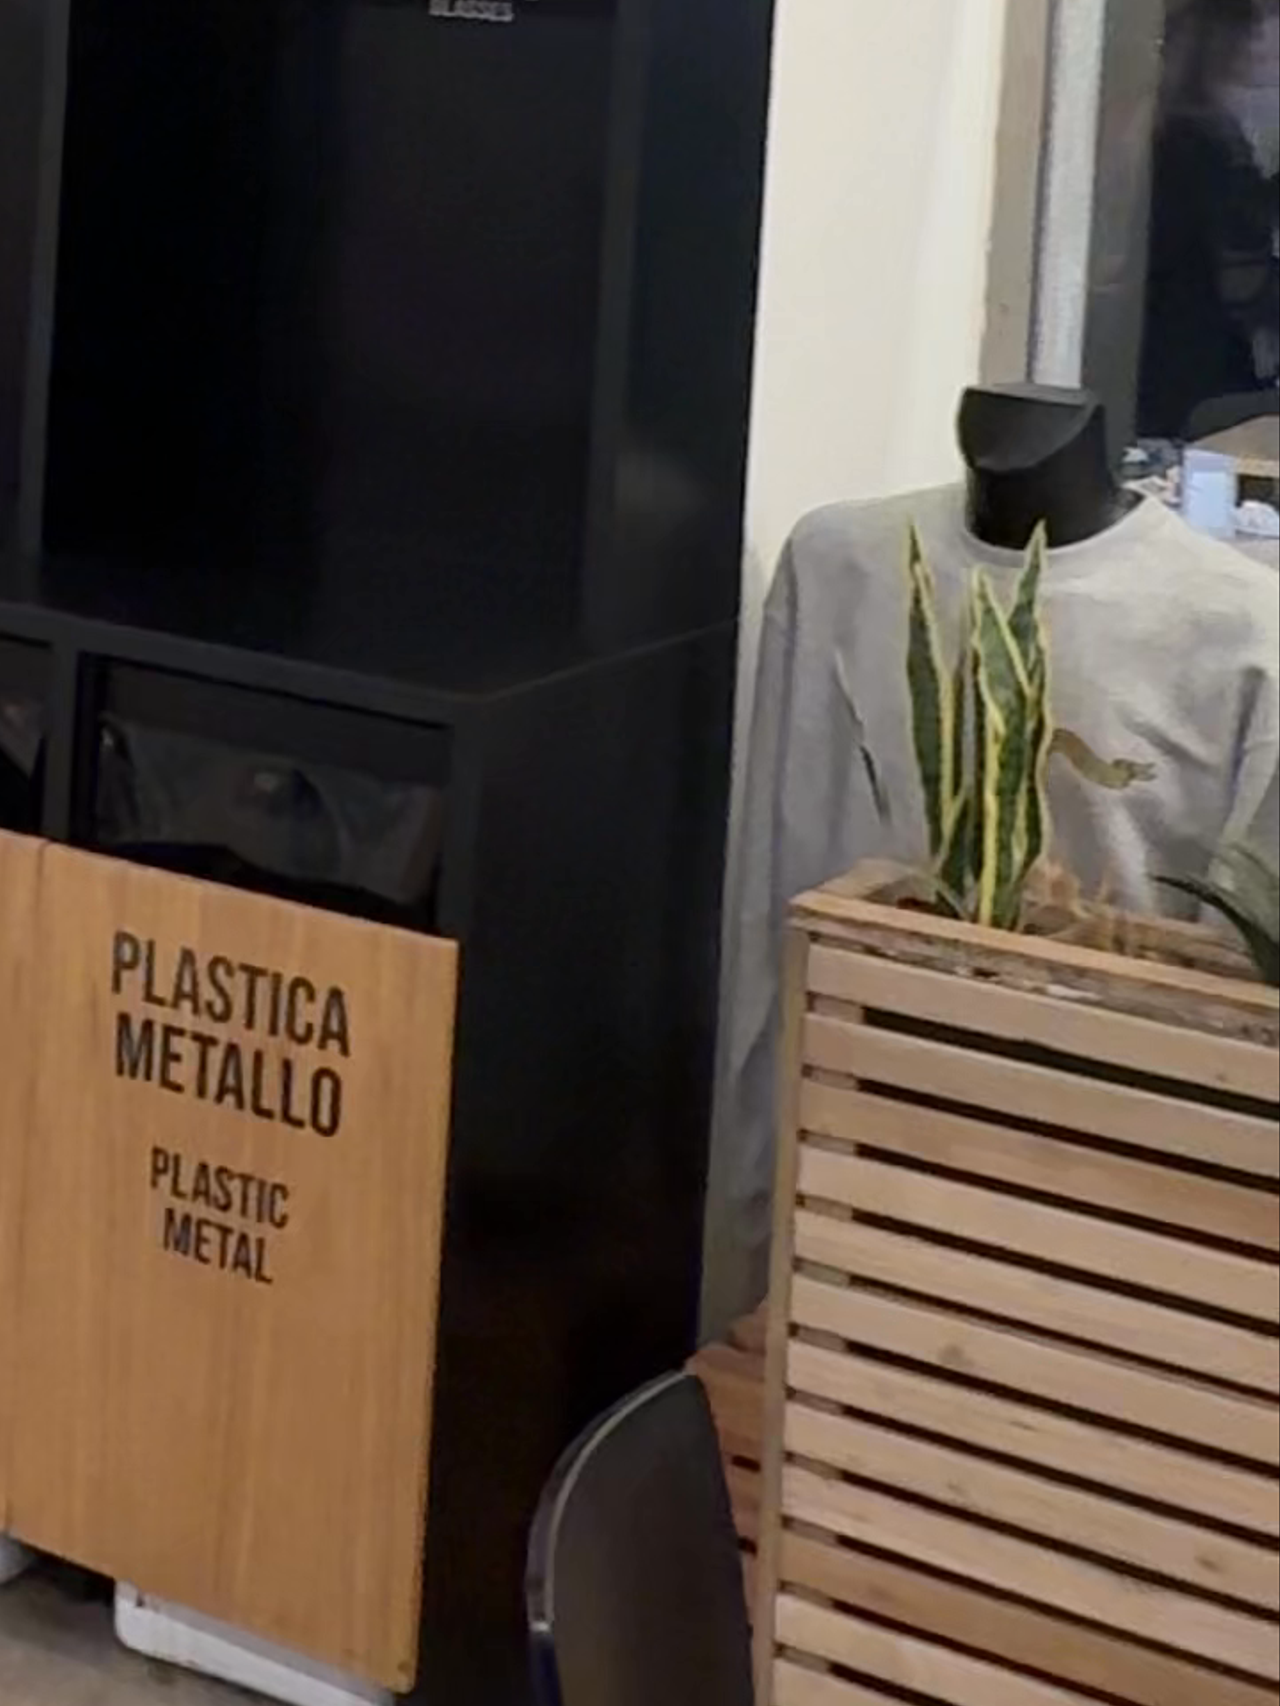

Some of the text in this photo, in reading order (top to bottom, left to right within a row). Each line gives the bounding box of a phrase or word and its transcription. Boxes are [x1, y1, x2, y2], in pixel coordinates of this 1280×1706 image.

[110, 929, 351, 1059] PLASTICA
[114, 1010, 342, 1138] METALLO
[149, 1146, 290, 1230] PLASTIC
[161, 1207, 275, 1286] METAL
